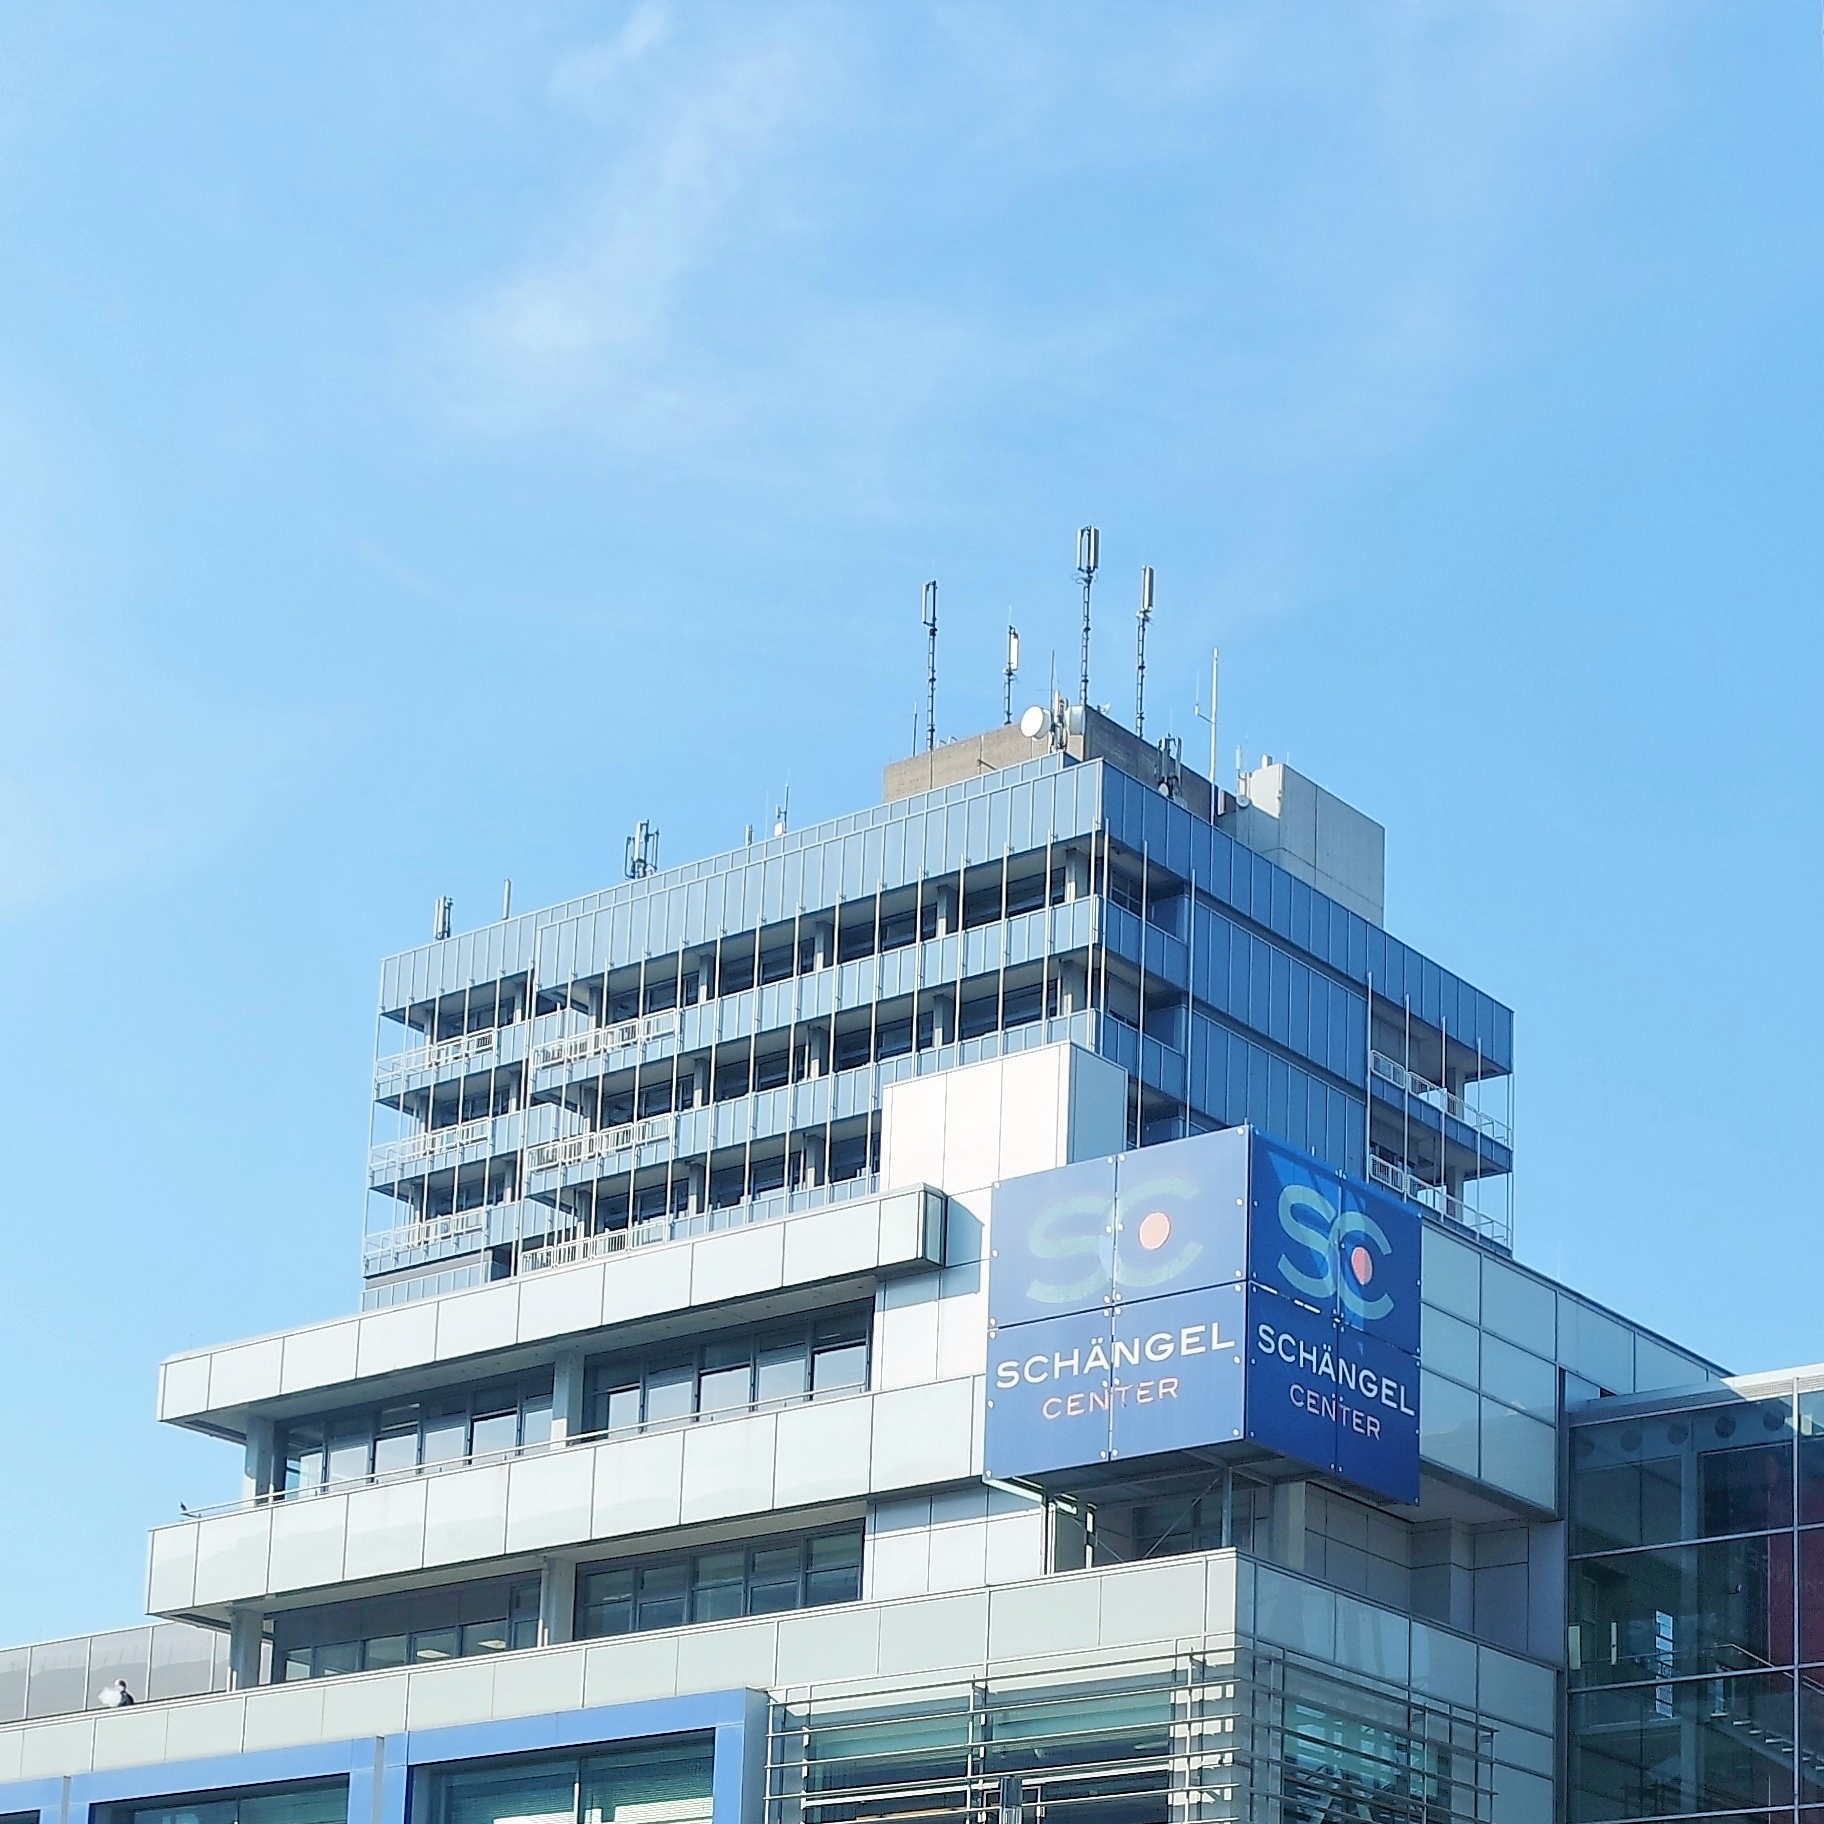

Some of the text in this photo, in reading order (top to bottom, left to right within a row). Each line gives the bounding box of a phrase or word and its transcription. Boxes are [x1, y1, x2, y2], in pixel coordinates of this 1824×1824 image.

[995, 1321, 1236, 1389] SCHÄNGEL
[1257, 1323, 1416, 1417] SCHÄNGEL
[1041, 1377, 1180, 1421] CENTER
[1288, 1382, 1381, 1440] CENTER
